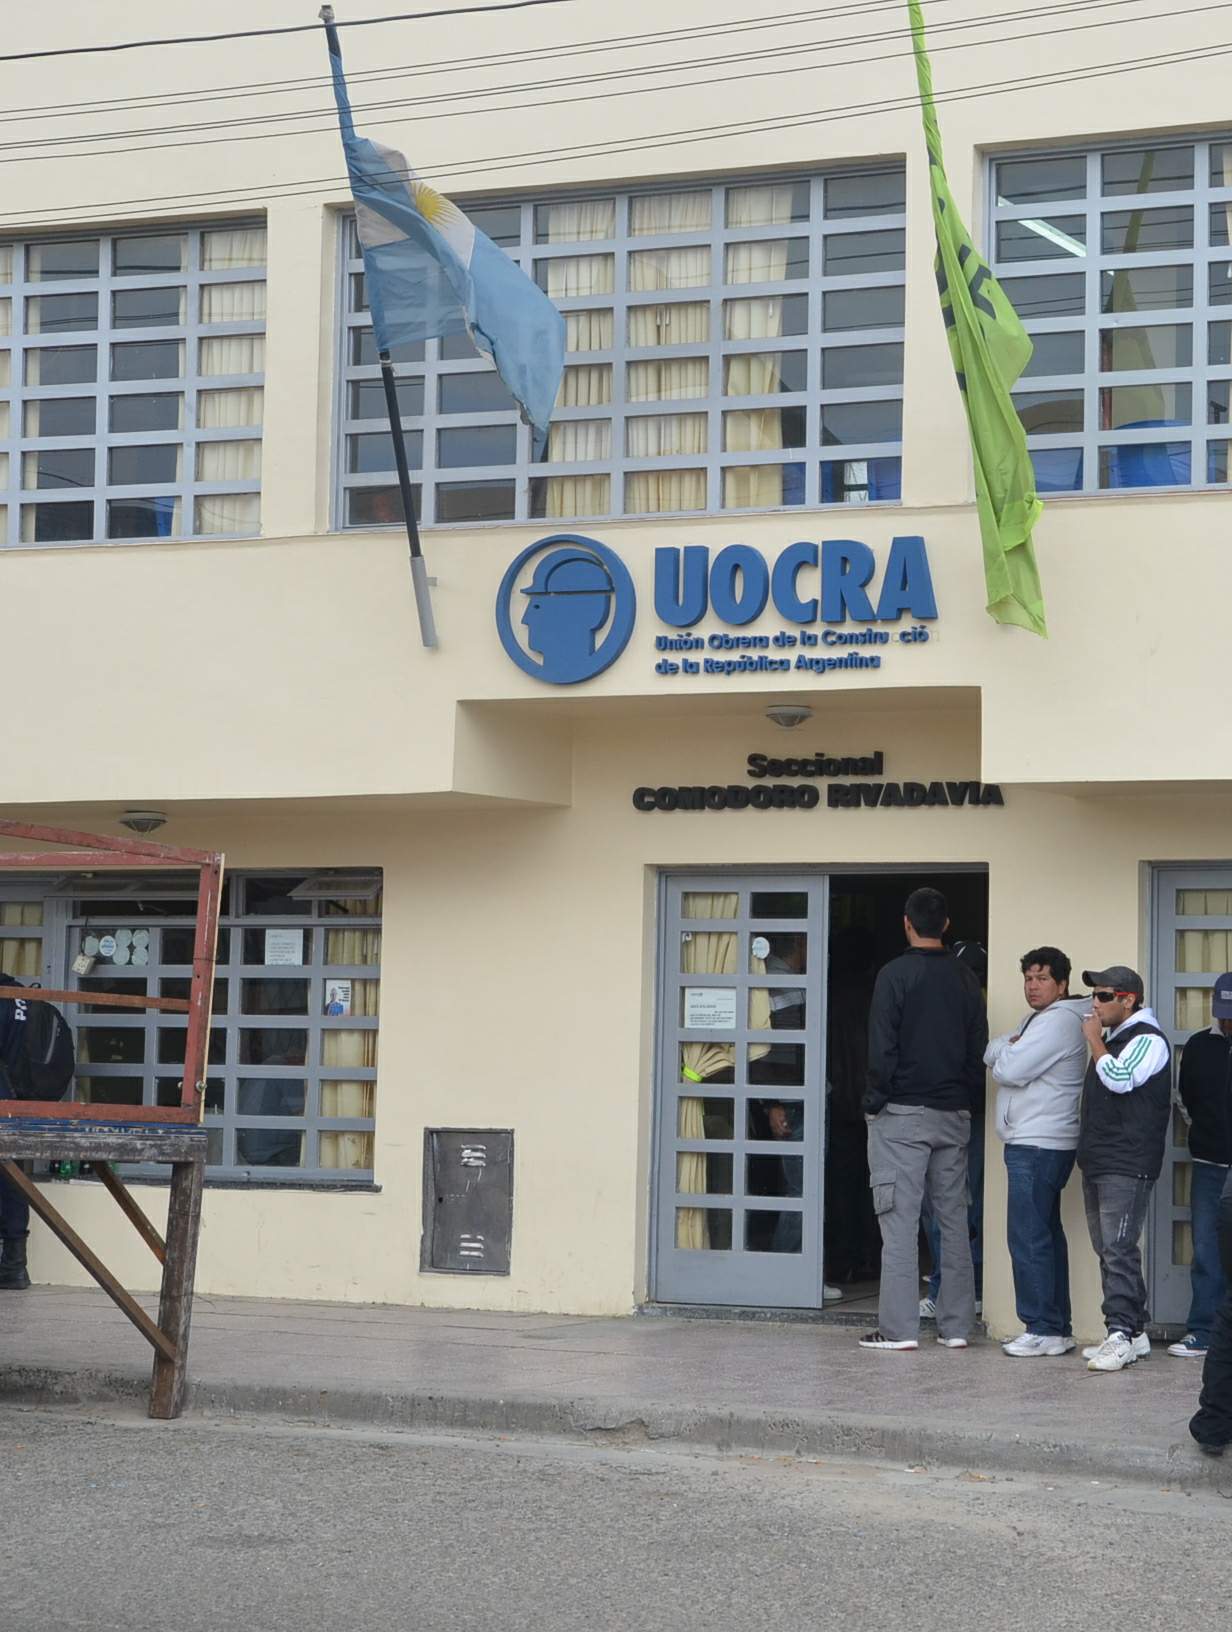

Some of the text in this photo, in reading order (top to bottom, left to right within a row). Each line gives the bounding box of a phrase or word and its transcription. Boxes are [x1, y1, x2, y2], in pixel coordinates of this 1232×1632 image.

[654, 535, 938, 627] UOCRA
[656, 631, 705, 651] Unión
[708, 633, 770, 650] Obrera
[772, 631, 798, 648] de
[800, 630, 818, 646] la
[655, 651, 881, 676] de la República Argentina
[747, 751, 884, 778] Seccional
[632, 781, 1004, 811] COMODORO RIVADAVIA
